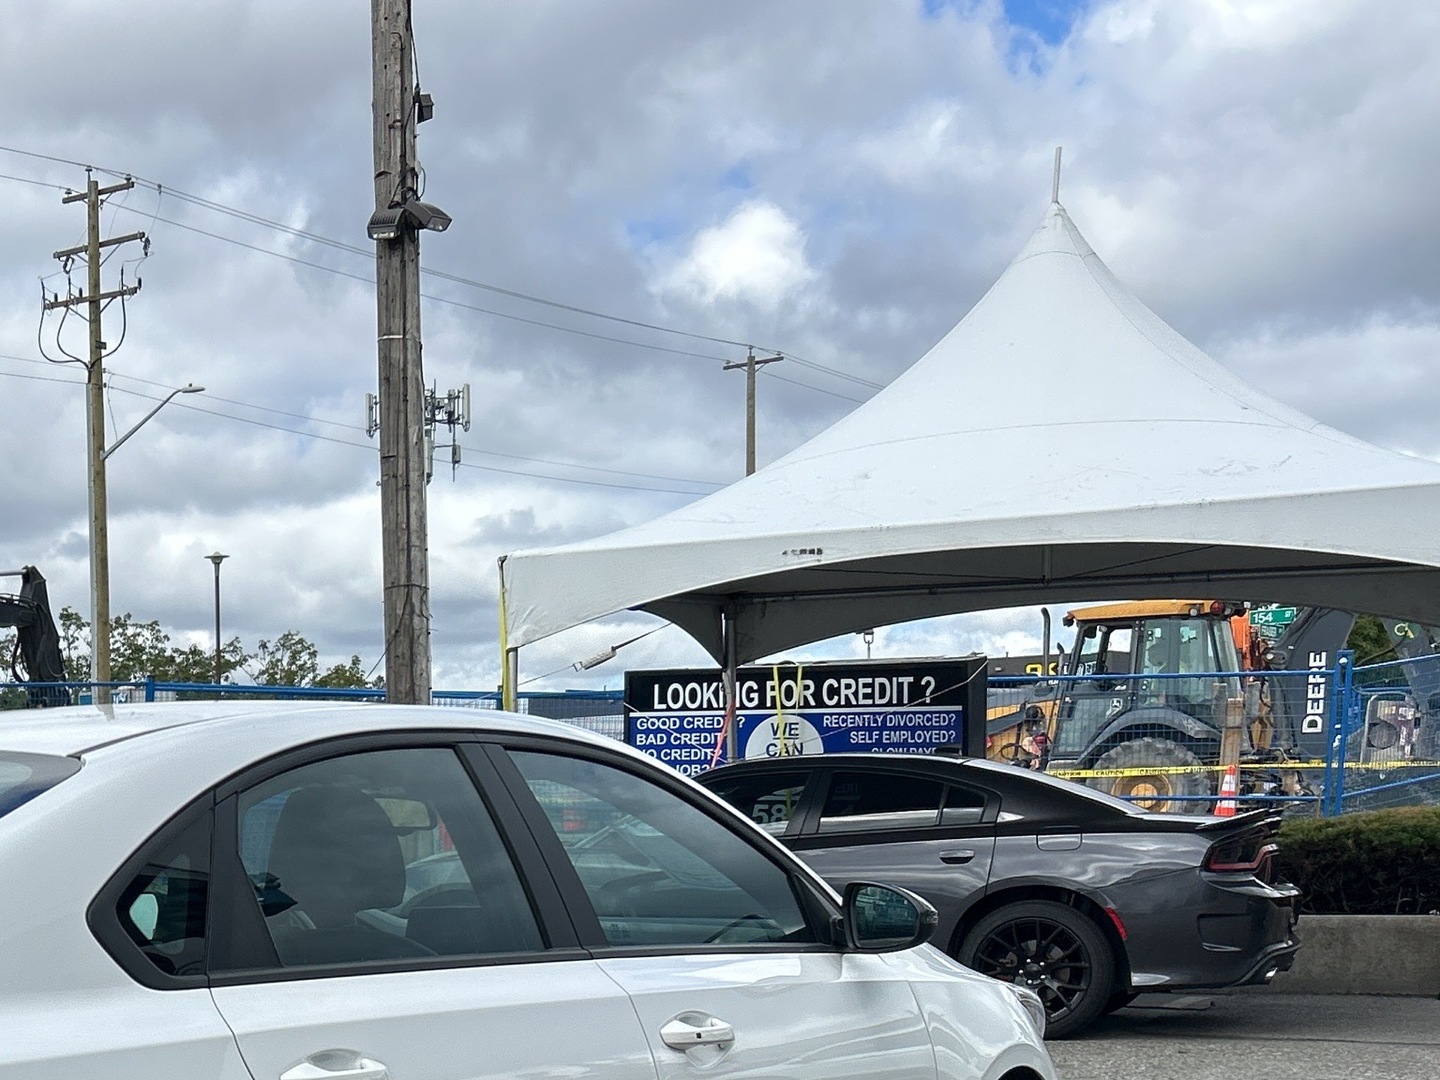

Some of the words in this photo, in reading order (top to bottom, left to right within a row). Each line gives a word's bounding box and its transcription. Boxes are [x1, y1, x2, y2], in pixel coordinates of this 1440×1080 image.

[1252, 611, 1274, 624] 154
[765, 678, 816, 707] FOR
[822, 676, 914, 706] CREDIT
[920, 675, 936, 704] ?
[1301, 651, 1327, 733] DEERE
[636, 717, 680, 730] GOOD
[683, 716, 746, 729] CRED?
[823, 714, 884, 728] RECENTLY
[886, 713, 956, 727] DIVORCED?
[770, 722, 800, 737] WE
[850, 731, 879, 744] SELF
[882, 730, 956, 744] EMPLOYED?
[635, 733, 667, 746] BAD
[670, 732, 728, 746] CREDIT
[766, 742, 804, 757] CAN
